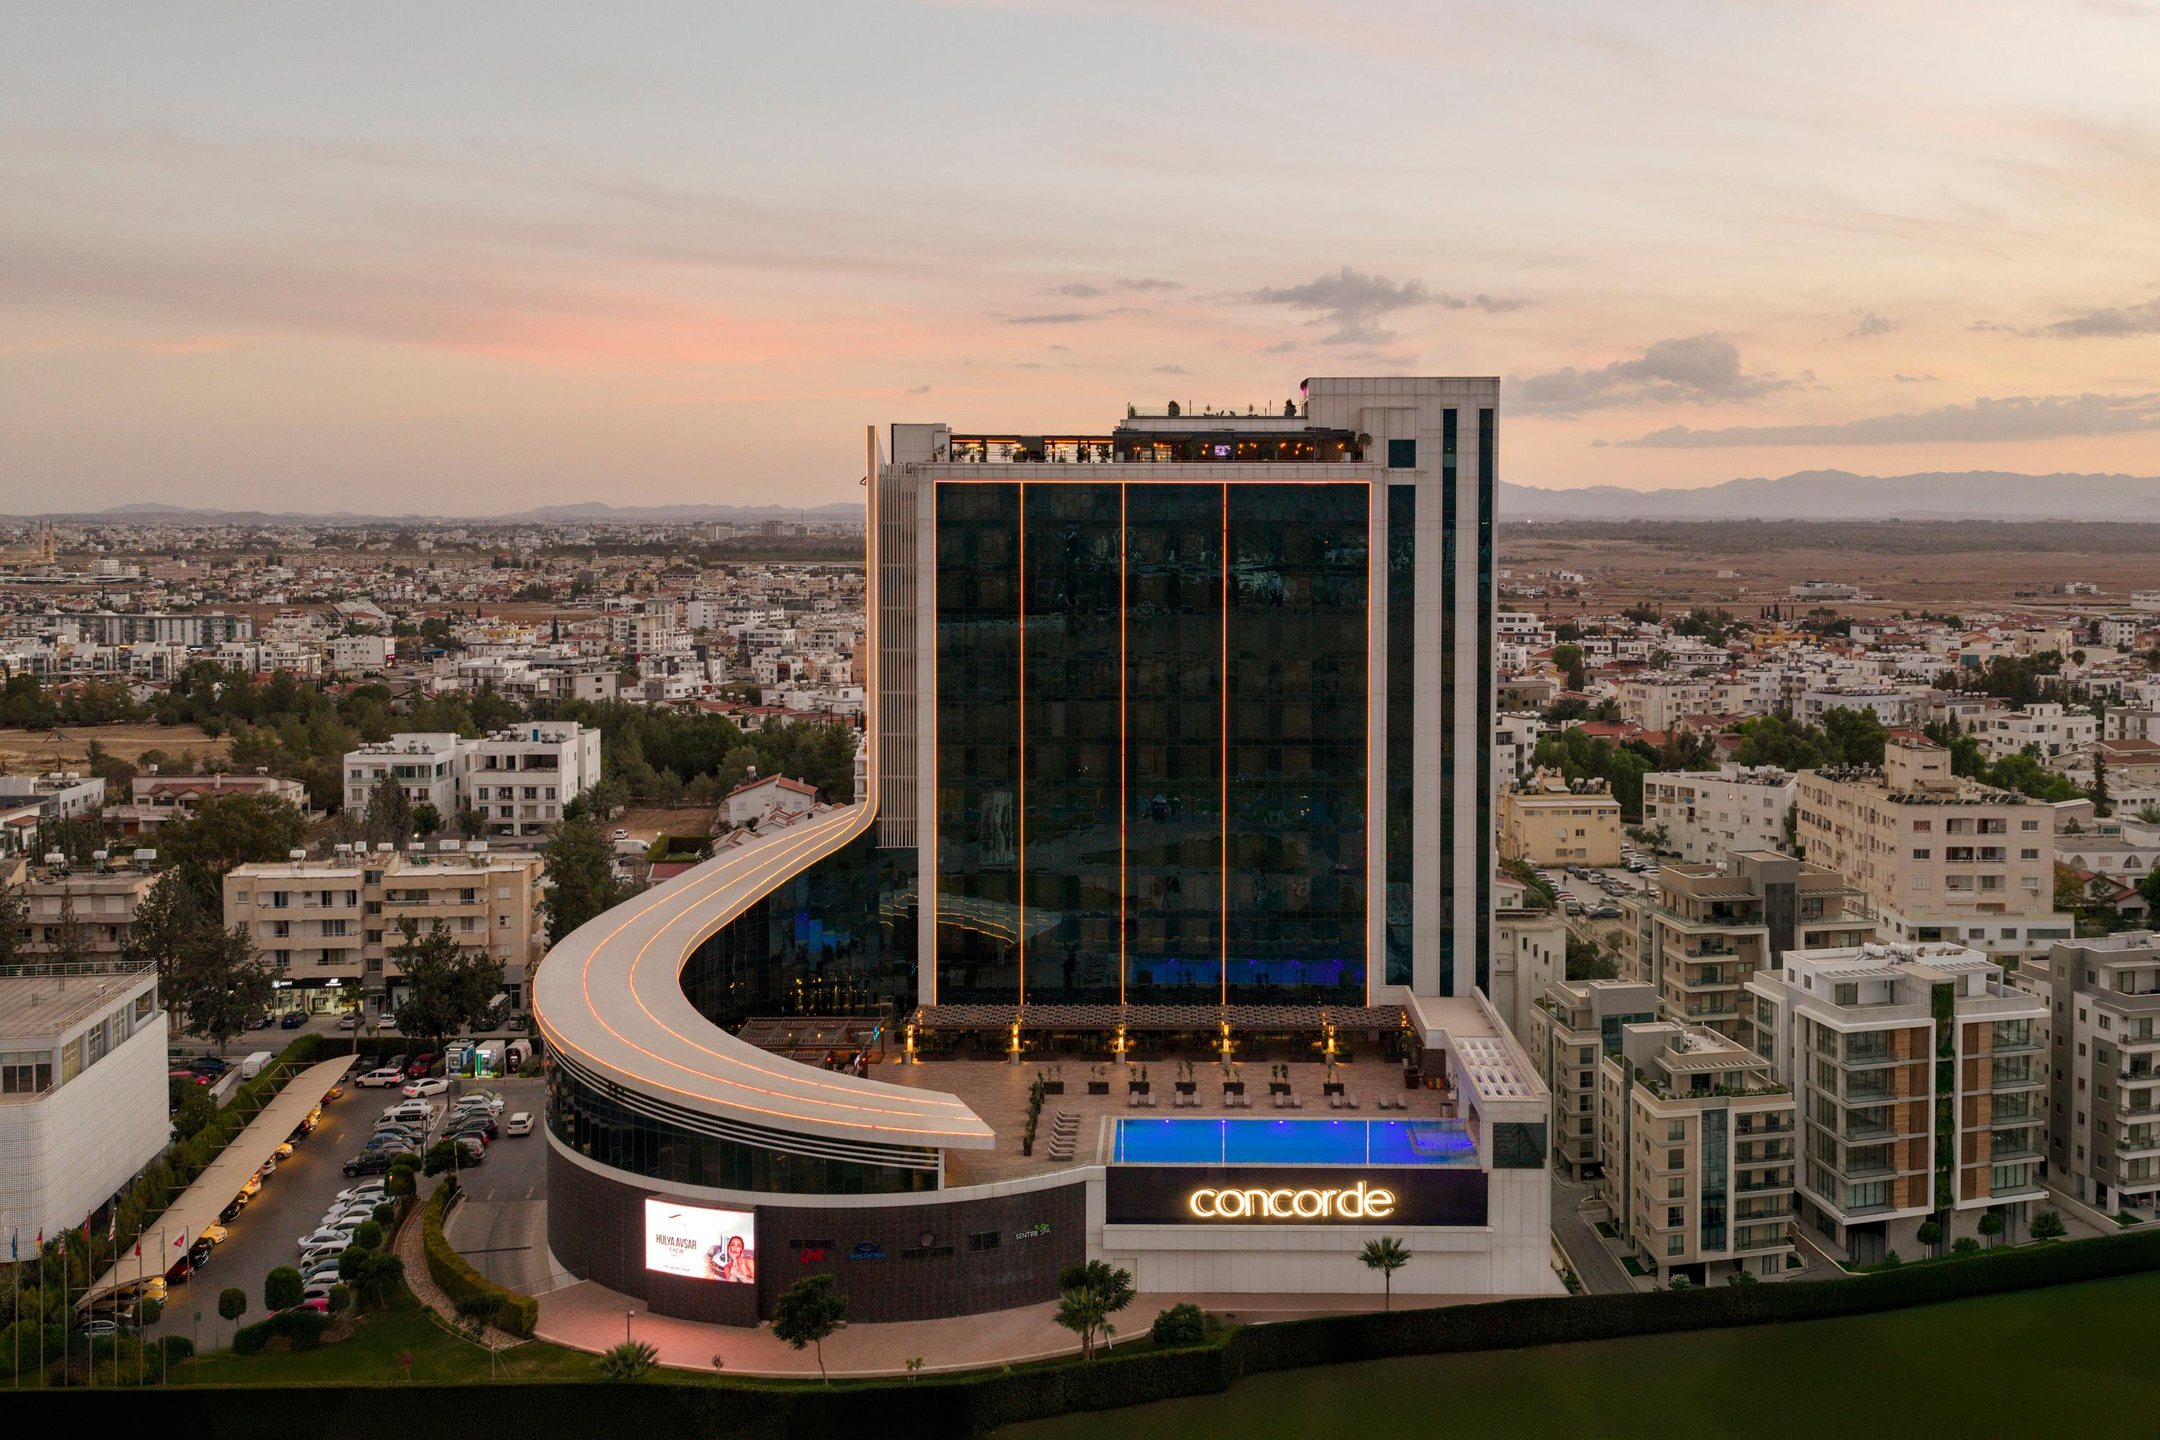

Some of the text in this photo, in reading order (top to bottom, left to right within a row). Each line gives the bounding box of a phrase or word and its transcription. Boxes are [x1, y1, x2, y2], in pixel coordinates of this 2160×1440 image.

[1190, 1181, 1396, 1217] concorde
[656, 1233, 697, 1251] HÜLYA AVŞAR
[1015, 1227, 1051, 1240] SENTIRE SPA
[801, 1247, 825, 1264] Grill
